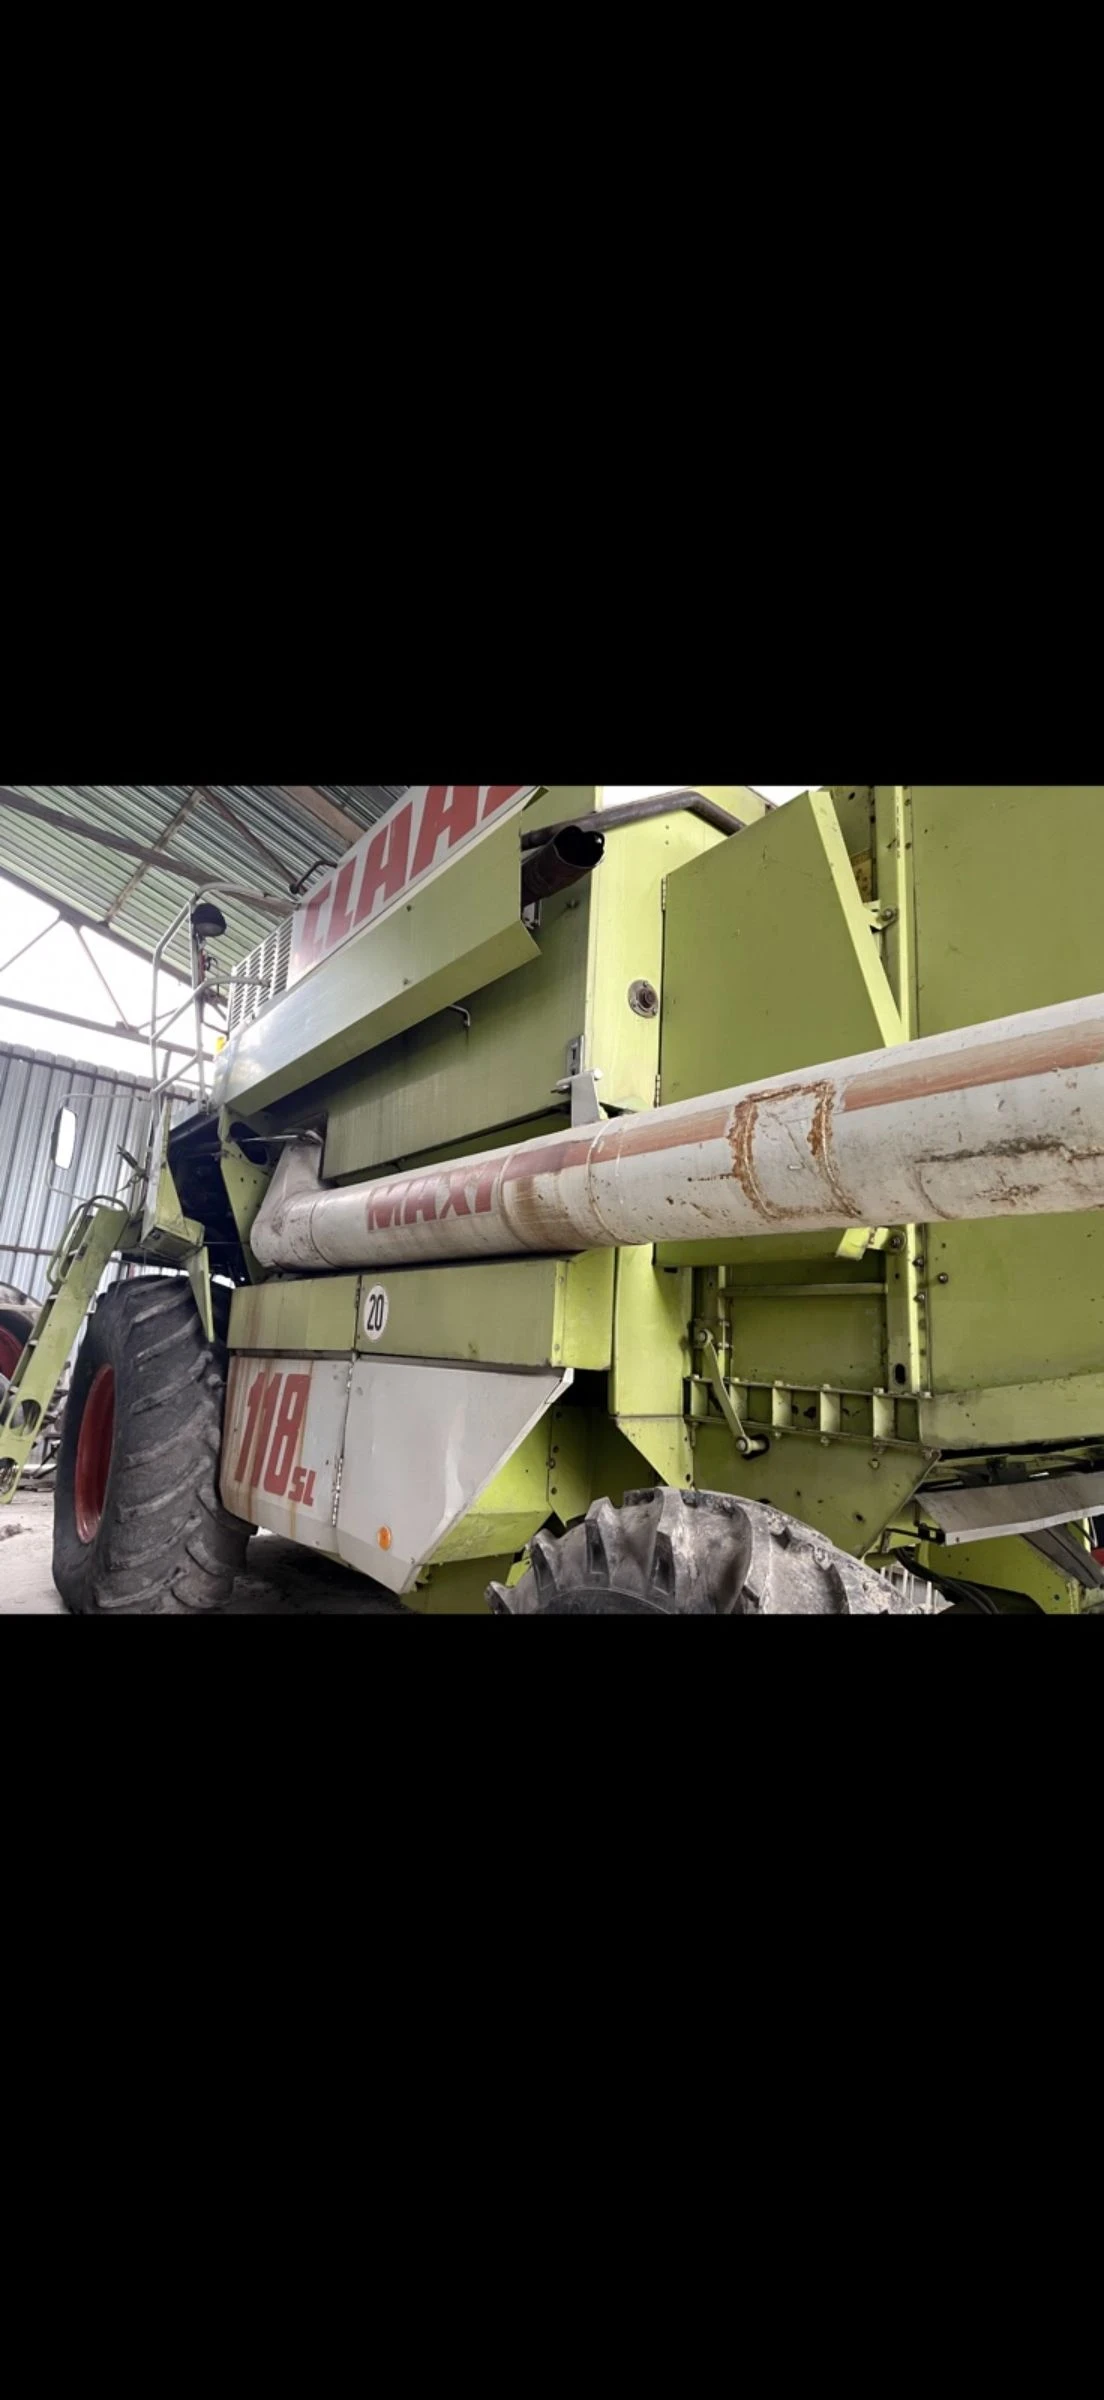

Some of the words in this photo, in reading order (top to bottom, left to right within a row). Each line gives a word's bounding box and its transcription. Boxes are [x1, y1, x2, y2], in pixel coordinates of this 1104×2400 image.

[302, 785, 523, 967] CLAA
[367, 1164, 495, 1231] MAXI
[367, 1294, 385, 1332] 20
[234, 1372, 311, 1496] 118
[288, 1466, 317, 1507] SL
